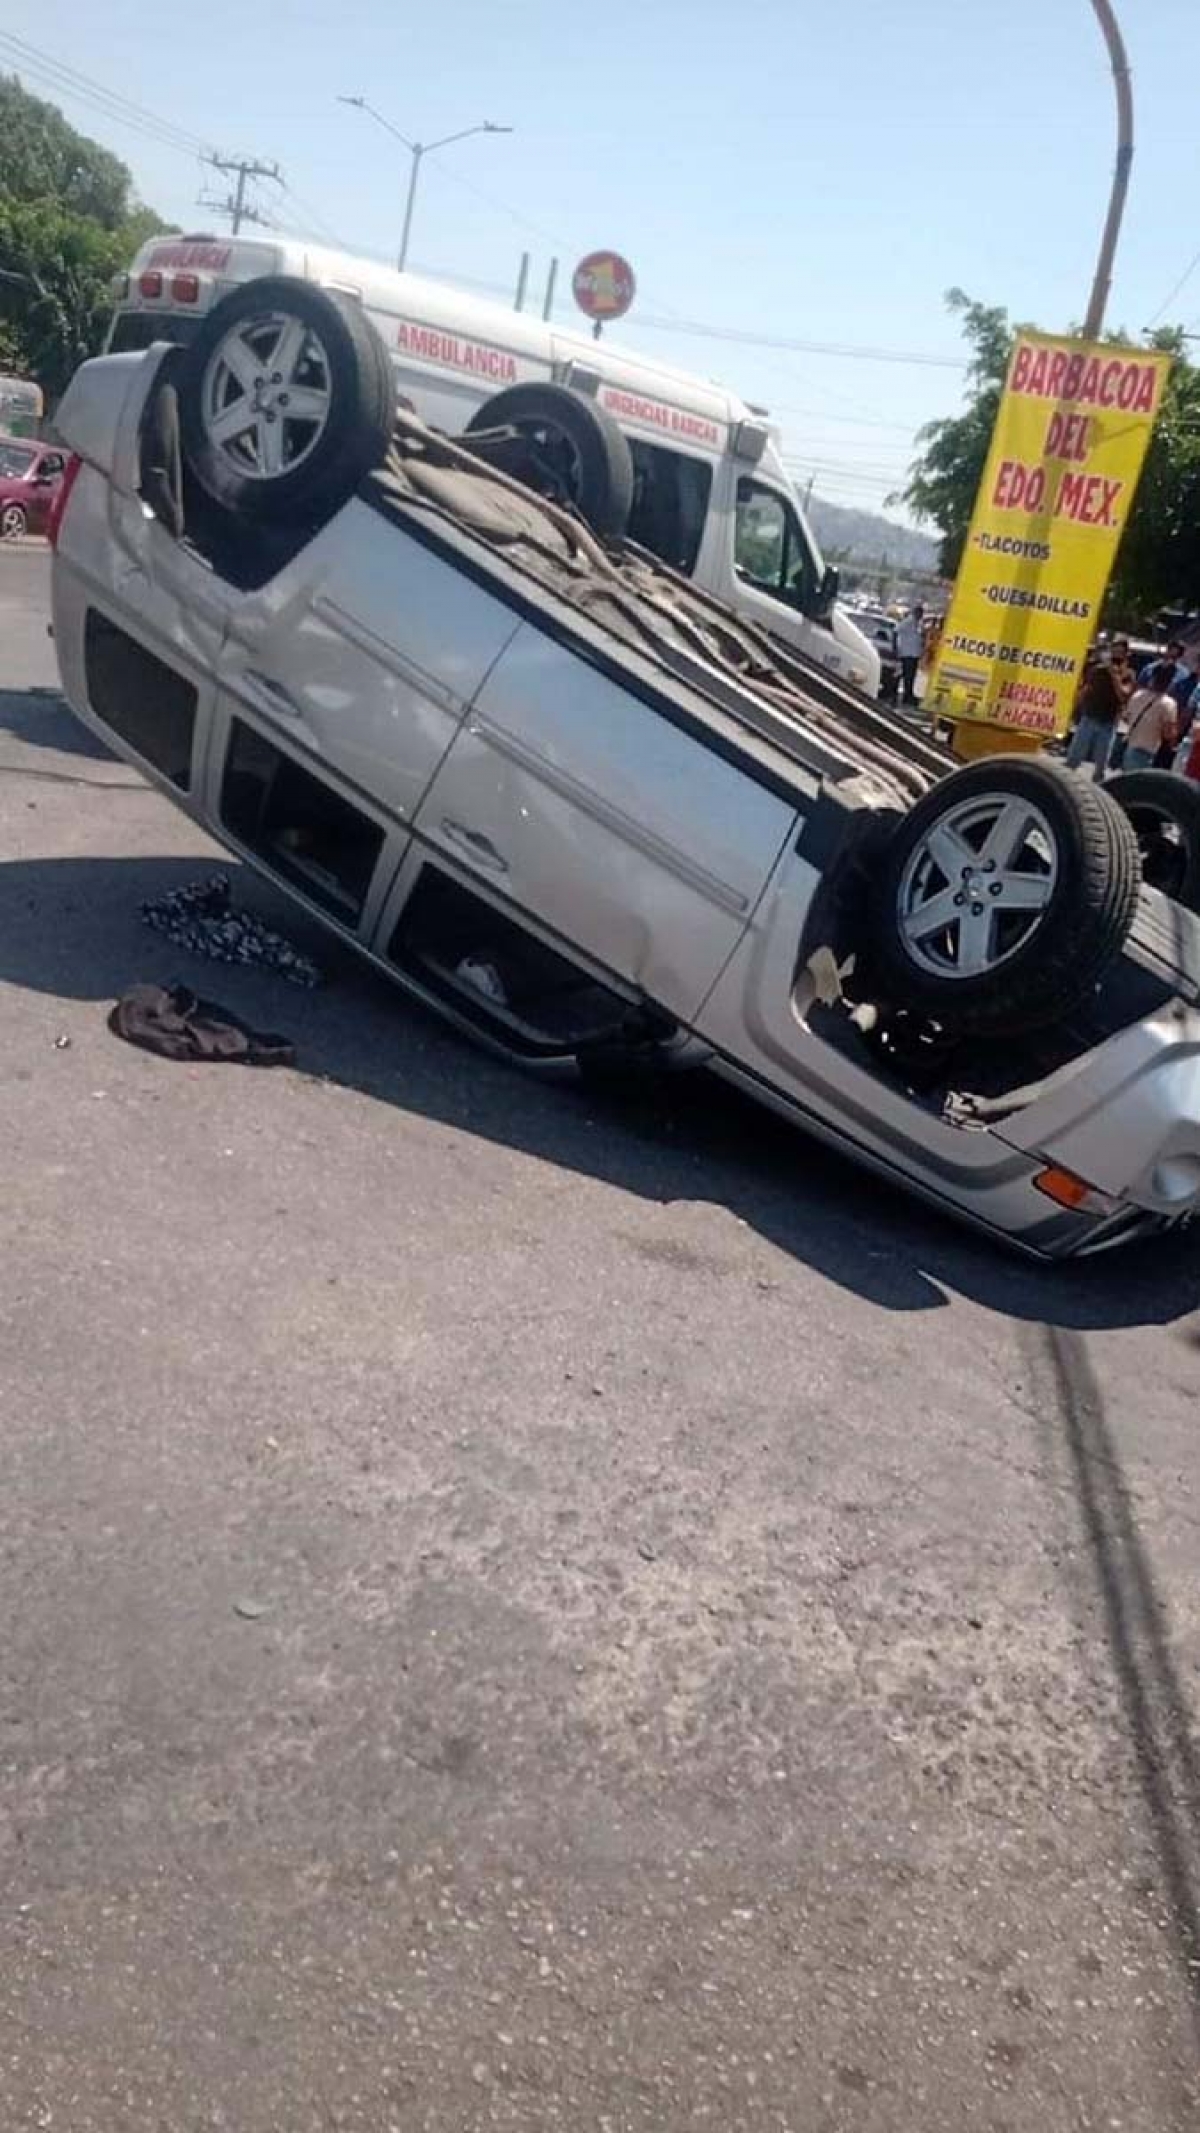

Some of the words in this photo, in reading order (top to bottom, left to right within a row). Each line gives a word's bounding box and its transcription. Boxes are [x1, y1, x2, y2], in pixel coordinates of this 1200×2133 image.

[398, 324, 517, 381] AMBULANCIA
[1010, 346, 1156, 412] BARBACOA
[604, 390, 668, 428] URGENCIAS
[1044, 411, 1090, 462] DEL
[993, 461, 1045, 513] EDO.
[1053, 472, 1123, 526] MEX.
[999, 645, 1019, 664] DE
[1022, 651, 1075, 673] CECINA
